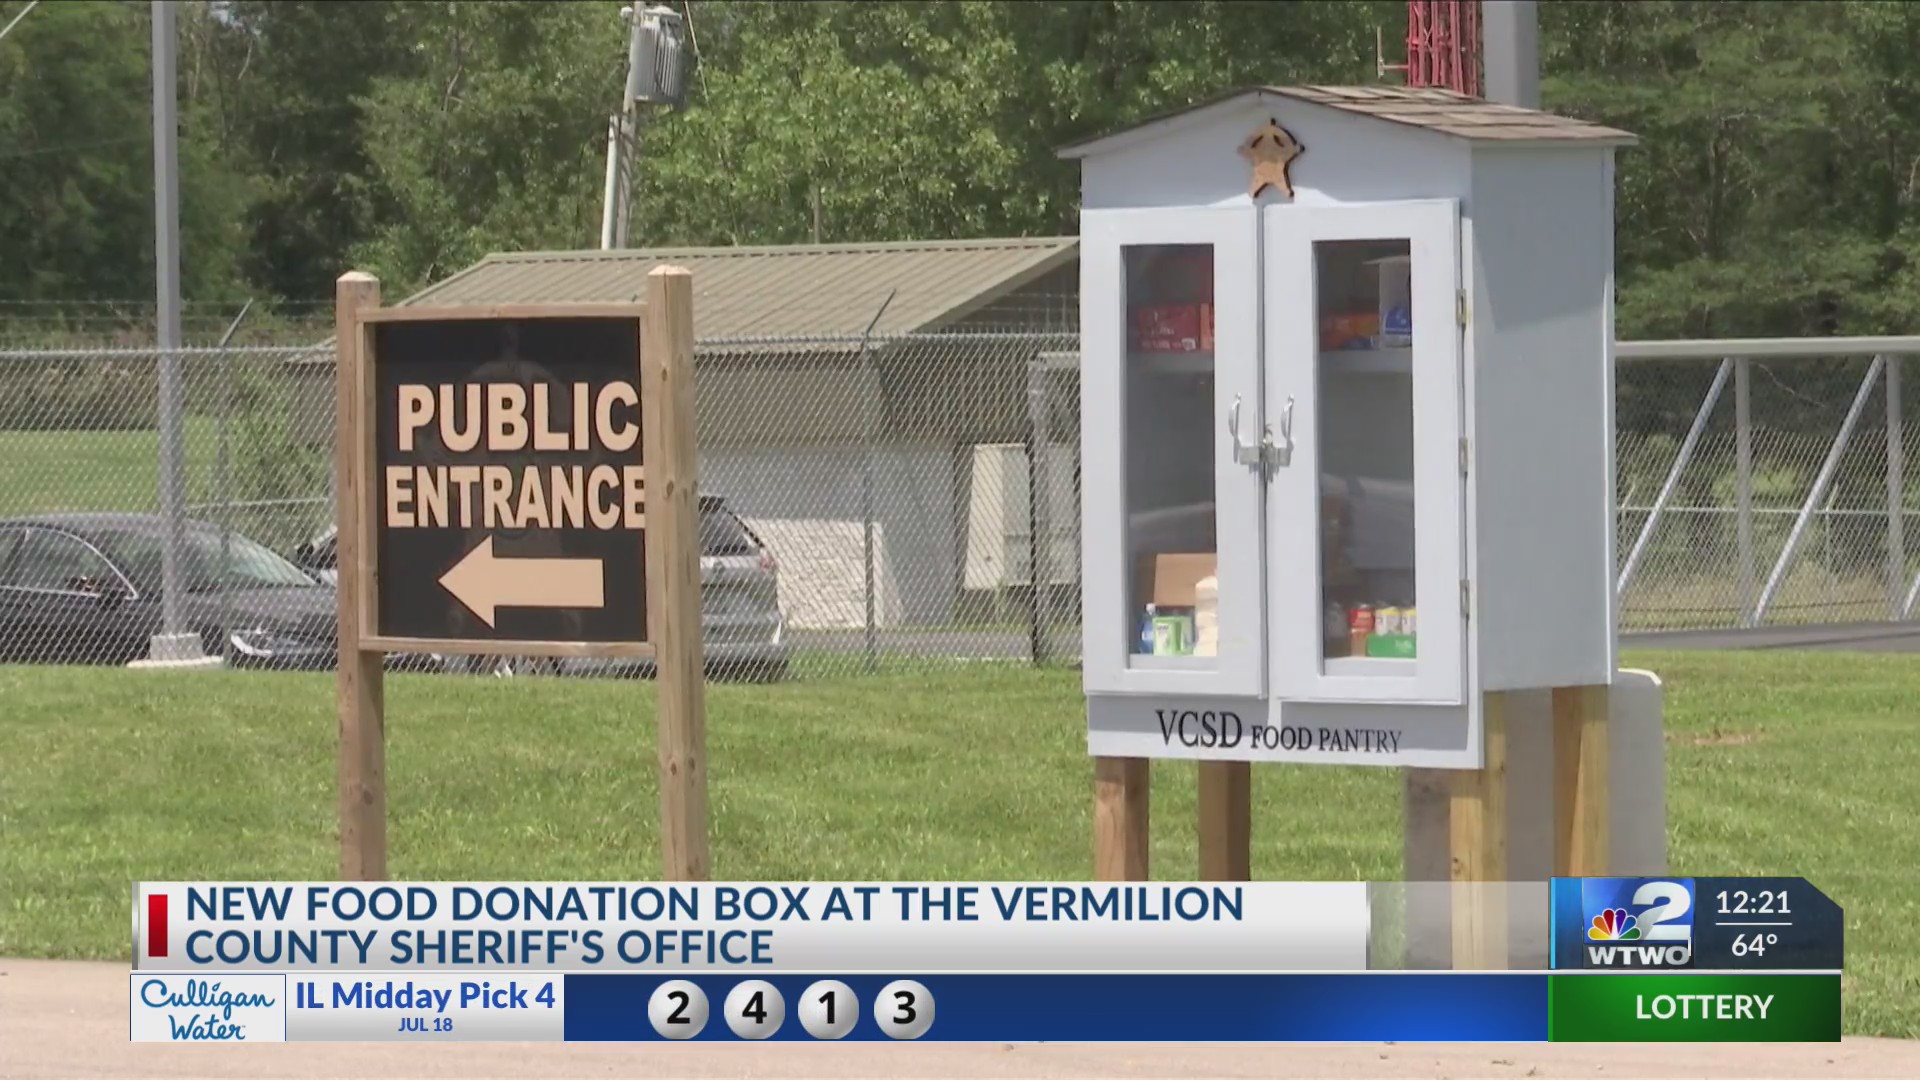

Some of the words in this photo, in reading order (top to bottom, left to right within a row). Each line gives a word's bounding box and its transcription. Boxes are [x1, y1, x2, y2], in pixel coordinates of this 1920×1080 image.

[397, 381, 640, 451] PUBLIC
[385, 464, 646, 529] ENTRANCE
[1156, 709, 1242, 748] VCSD
[1250, 725, 1312, 750] FOOD
[1318, 727, 1402, 753] PANTRY
